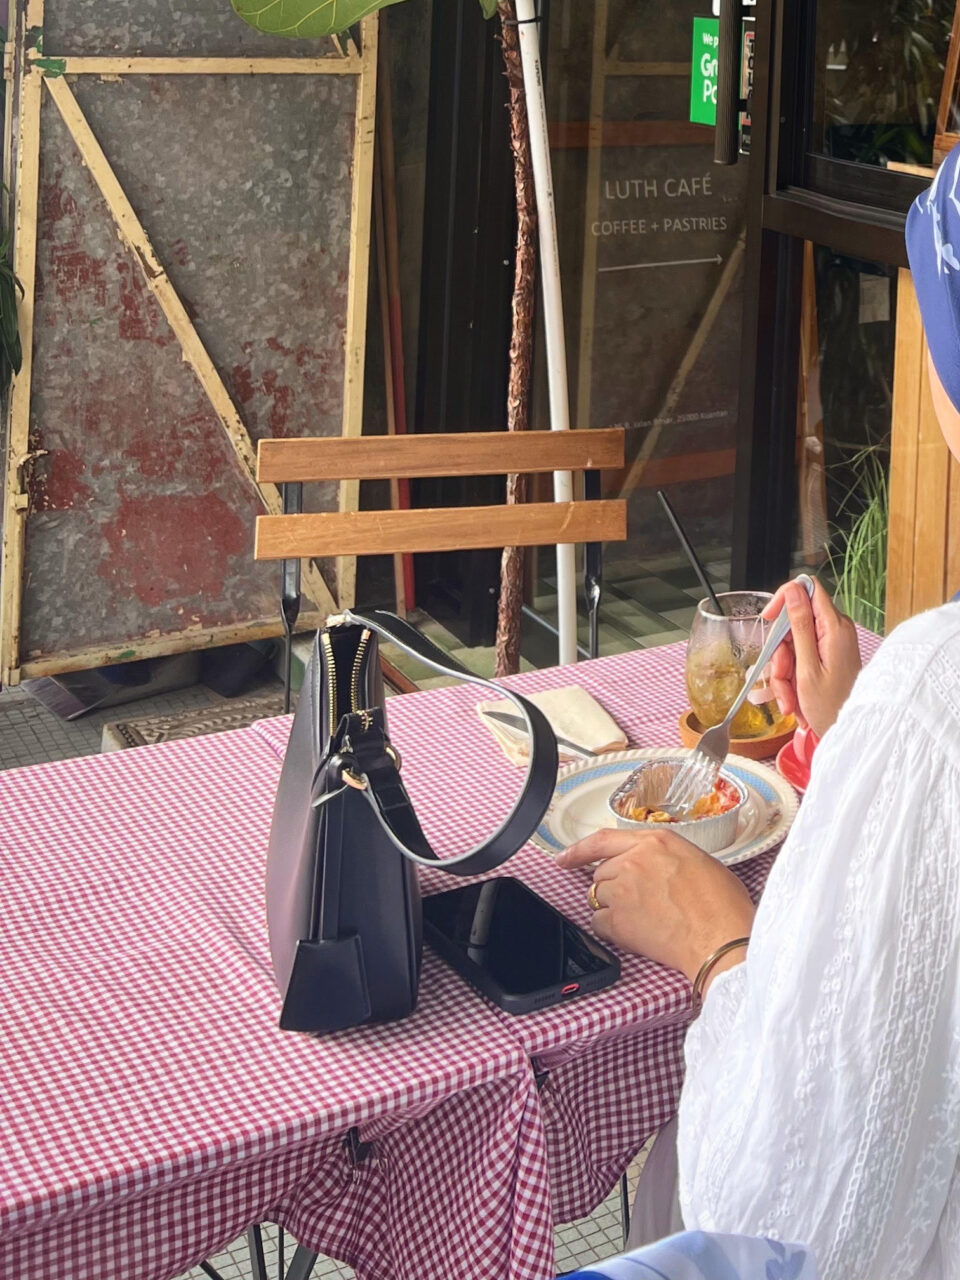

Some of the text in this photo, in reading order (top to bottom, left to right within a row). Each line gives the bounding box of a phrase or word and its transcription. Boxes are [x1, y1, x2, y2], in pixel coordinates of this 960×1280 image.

[605, 172, 713, 200] LUTH CAFÉ
[591, 219, 648, 237] COFFEE
[664, 216, 728, 233] PASTRIES
